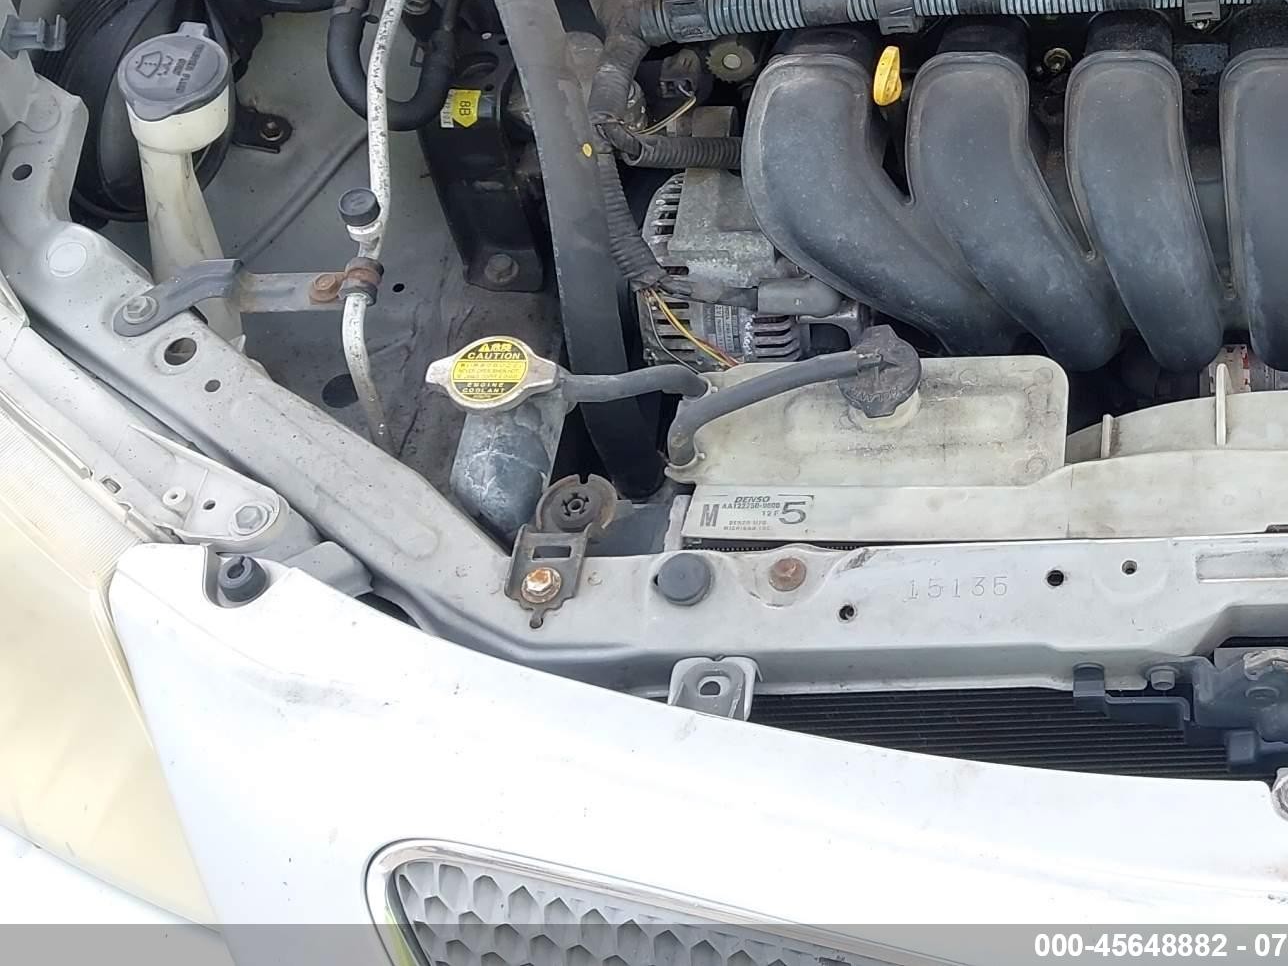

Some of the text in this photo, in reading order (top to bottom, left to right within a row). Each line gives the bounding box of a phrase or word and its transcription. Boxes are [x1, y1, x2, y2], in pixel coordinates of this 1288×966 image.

[467, 352, 520, 360] CAUTION
[734, 495, 770, 503] DENSO
[700, 503, 720, 527] M
[778, 501, 806, 525] 5
